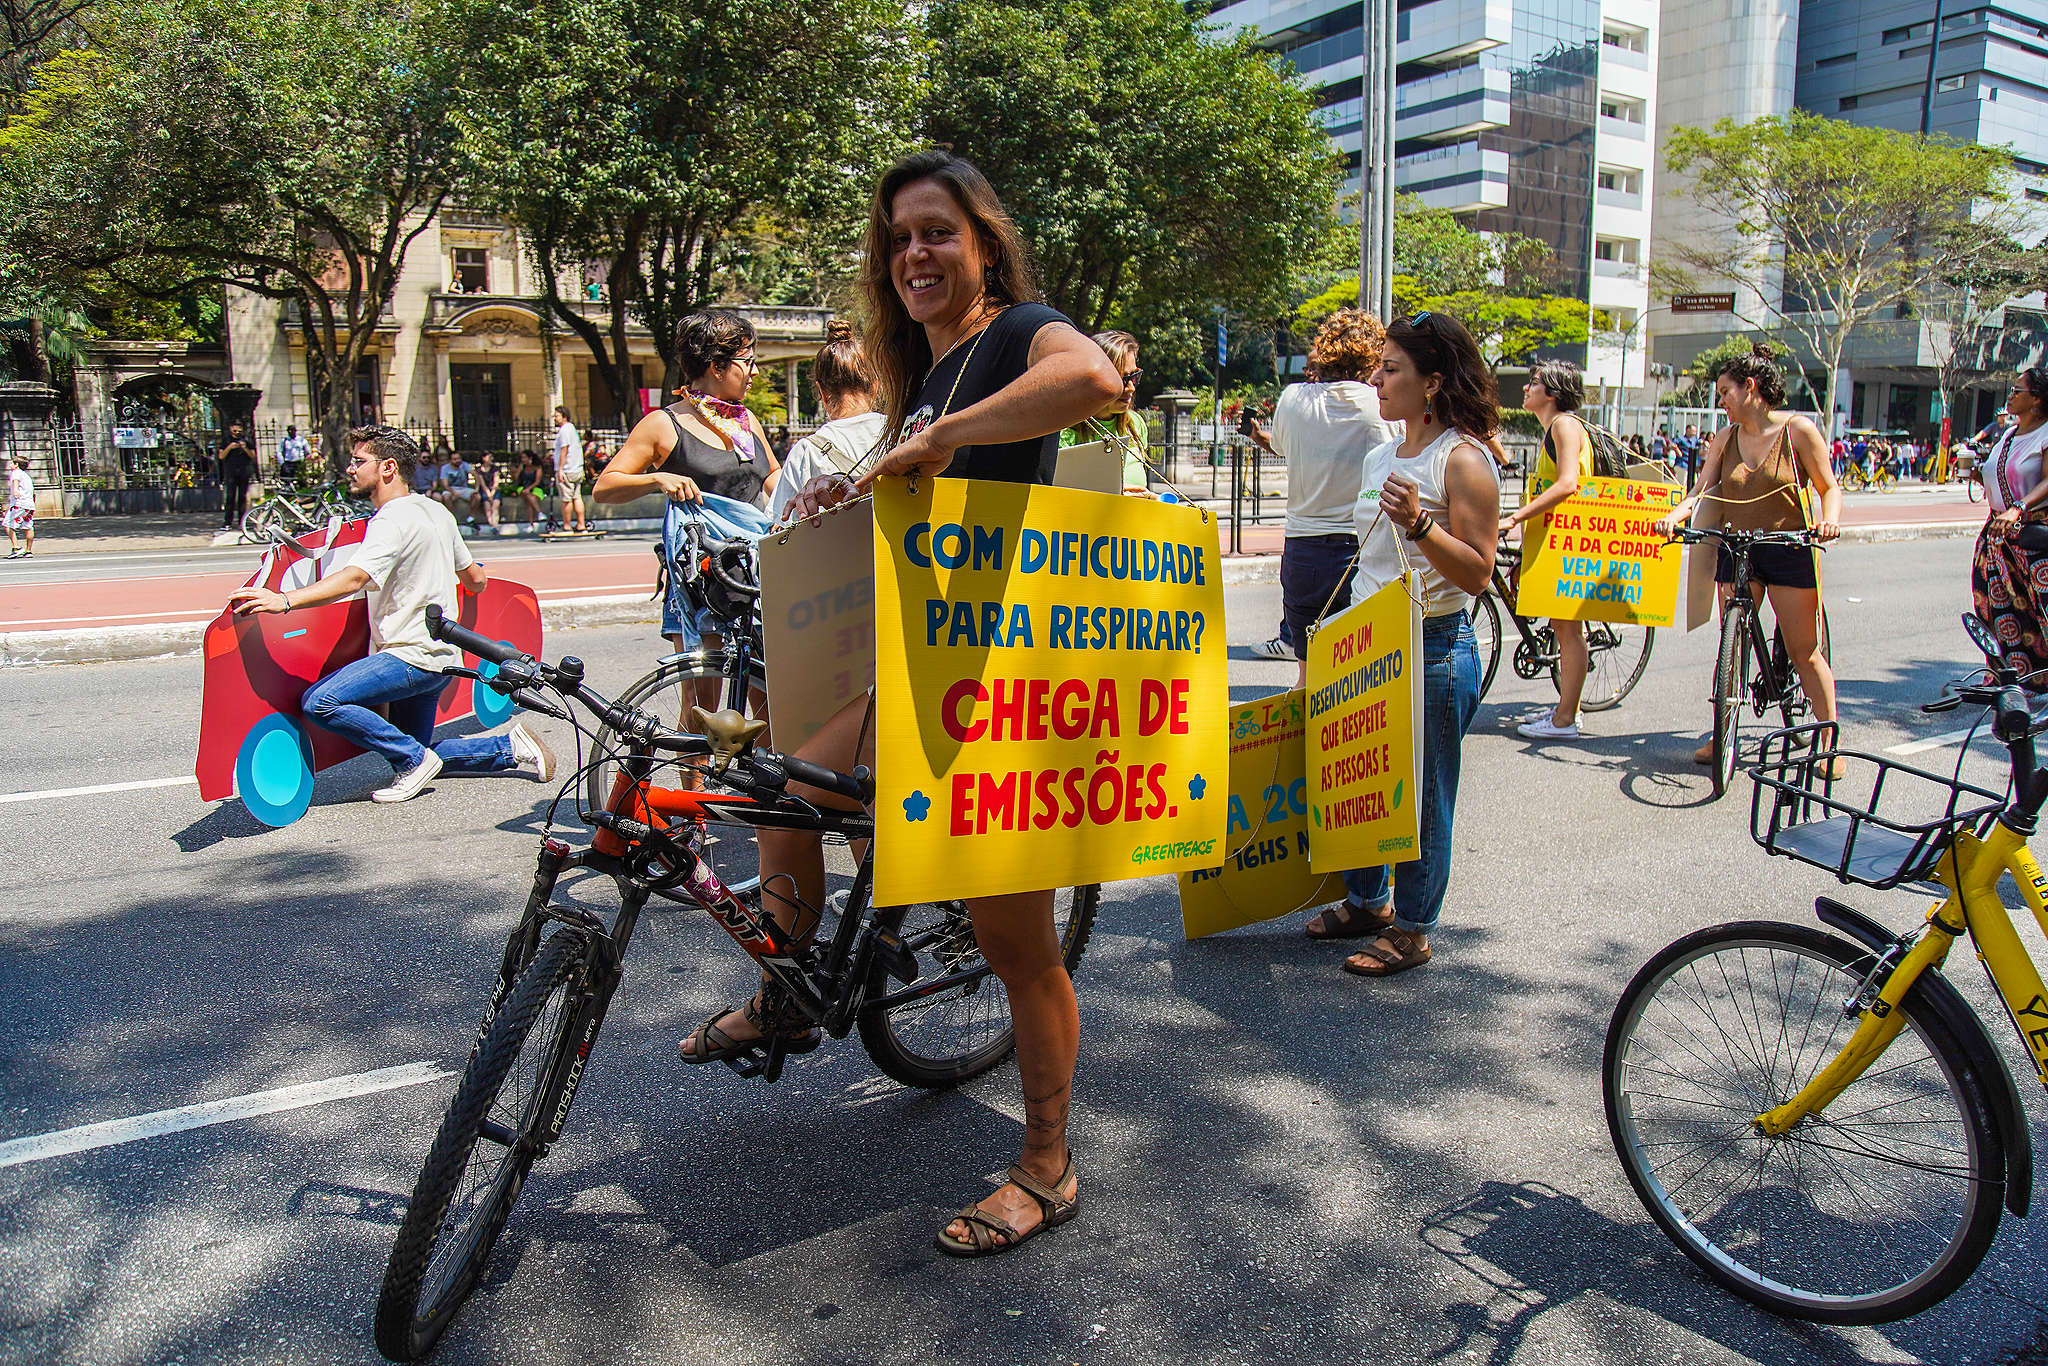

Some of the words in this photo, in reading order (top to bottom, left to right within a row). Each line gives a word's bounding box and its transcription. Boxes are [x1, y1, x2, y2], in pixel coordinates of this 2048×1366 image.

[1699, 296, 1708, 304] das
[1710, 296, 1729, 304] Rosas
[1543, 512, 1582, 531] PELA
[1588, 516, 1617, 534] SUA
[1623, 518, 1668, 538] SAÚD
[1549, 534, 1557, 550] E
[1562, 535, 1573, 551] A
[1579, 537, 1602, 554] DA
[1608, 540, 1663, 562] CIDADE,
[904, 522, 1004, 571] COM
[1020, 528, 1205, 586] DIFICULDADE
[1562, 556, 1602, 577] VEM
[1608, 560, 1642, 582] PRA
[1556, 579, 1642, 604] MARCHA!
[926, 599, 1034, 648] PARA
[1049, 605, 1205, 654] RESPIRAR?
[1332, 636, 1354, 669] POR
[1357, 621, 1373, 656] UM
[1310, 648, 1403, 720] DESENVOLVIMENTO
[941, 678, 1120, 743] CHEGA
[1138, 678, 1190, 737] DE
[1321, 725, 1340, 752] QUE
[1342, 700, 1387, 743] RESPEITE
[1321, 766, 1333, 793] AS
[1335, 746, 1380, 786] PESSOAS
[1383, 743, 1390, 773] E
[950, 749, 1178, 837] EMISSÕES.
[1325, 804, 1332, 832] A
[1334, 790, 1390, 829] NATUREZA.
[1131, 838, 1217, 865] GREENPEACE
[1234, 836, 1289, 871] 16HS
[551, 1053, 586, 1134] PROSHOCK
